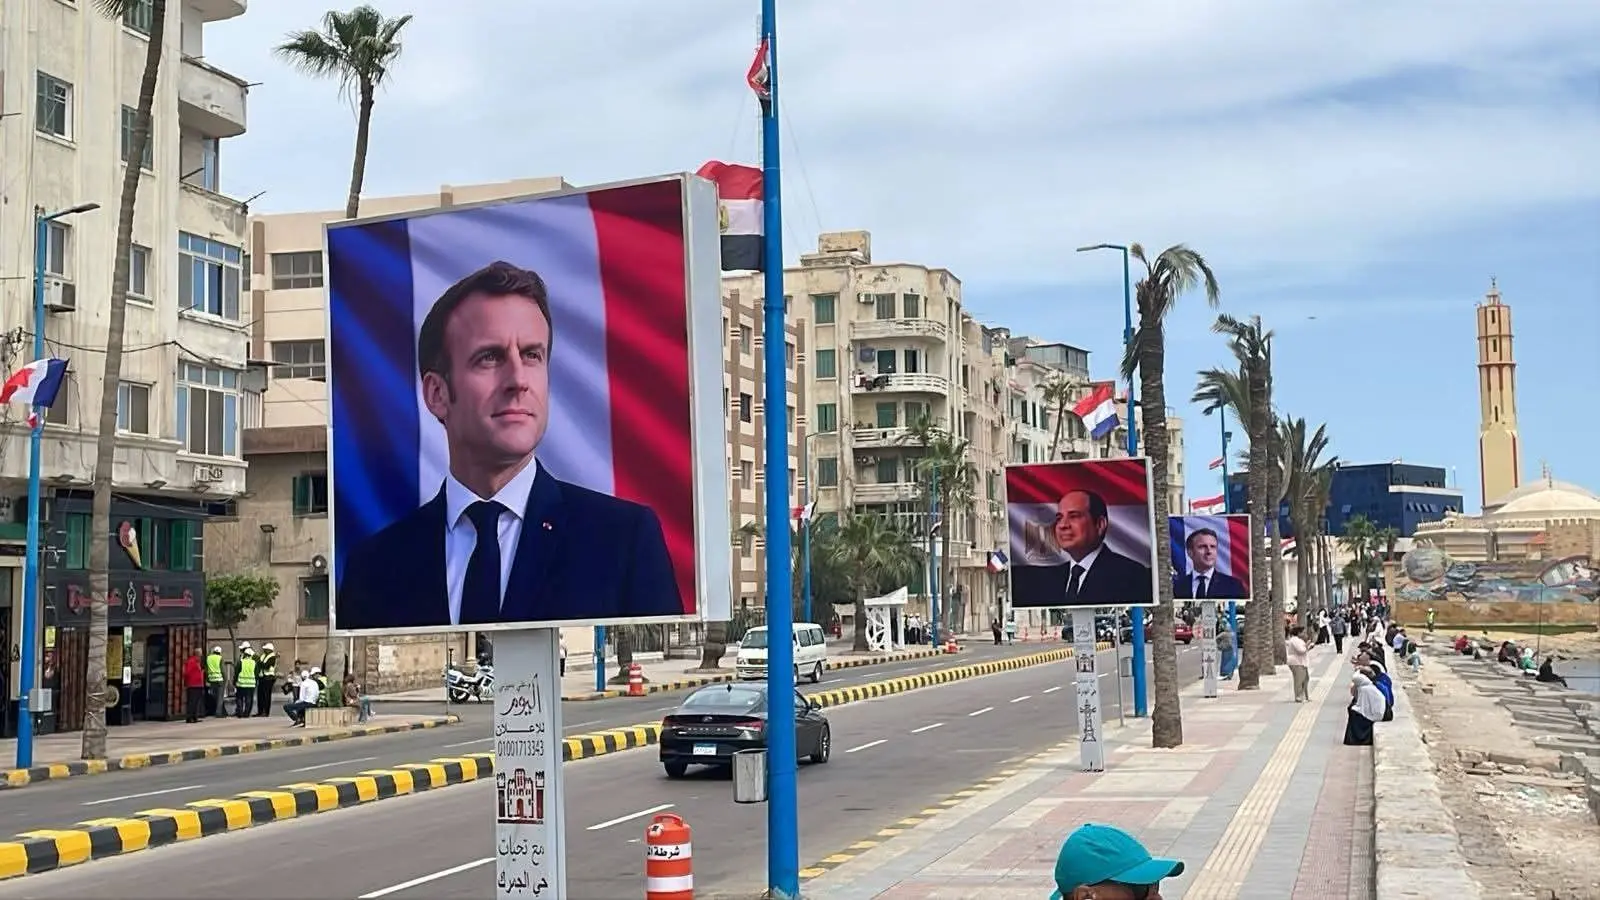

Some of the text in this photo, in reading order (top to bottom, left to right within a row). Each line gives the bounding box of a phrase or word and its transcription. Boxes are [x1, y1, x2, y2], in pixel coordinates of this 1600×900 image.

[500, 673, 542, 716] اليوم
[497, 740, 544, 757] 01001713343
[498, 834, 545, 866] مع تحيات
[654, 846, 680, 859] شرطة
[498, 870, 549, 897] حي الجمرك
